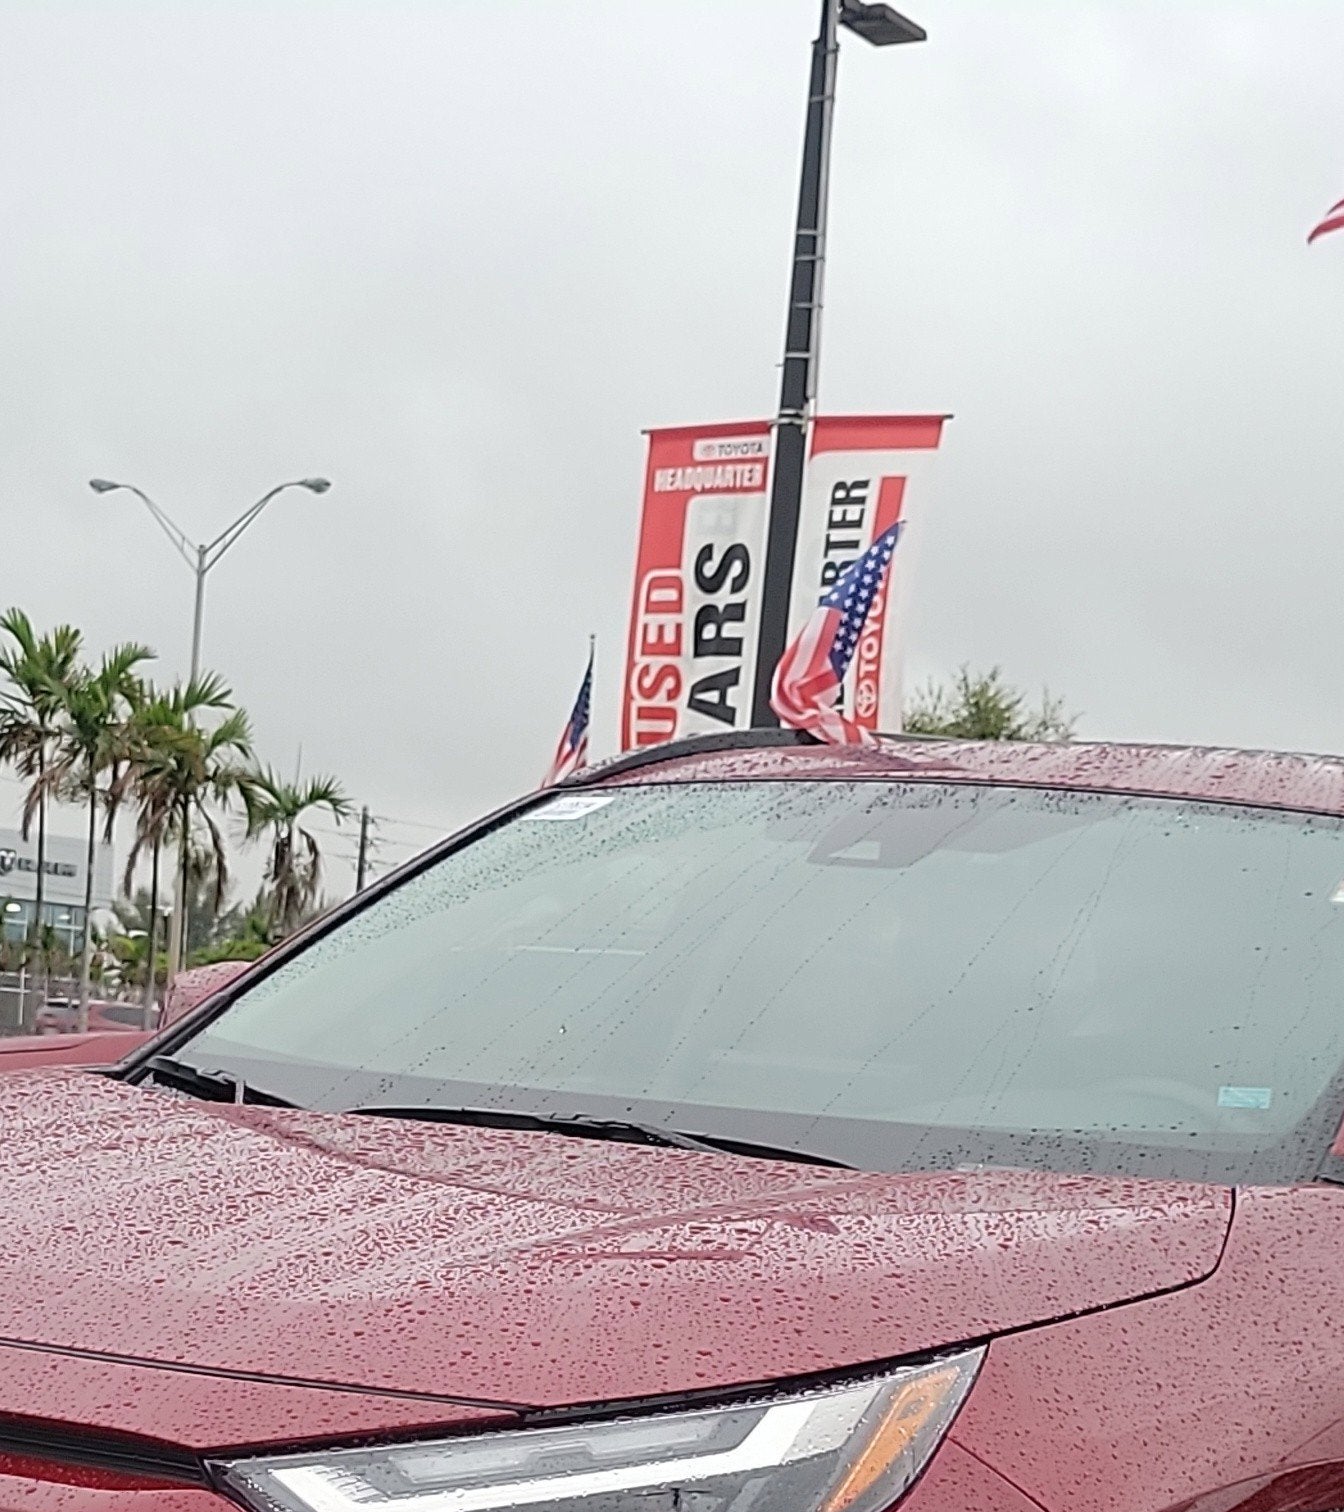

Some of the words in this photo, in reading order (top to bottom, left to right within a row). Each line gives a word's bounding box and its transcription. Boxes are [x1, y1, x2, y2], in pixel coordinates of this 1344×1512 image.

[654, 463, 763, 492] HEADQUARTER
[717, 442, 763, 455] TOYOTA
[636, 575, 684, 746] USED
[686, 542, 751, 737] ARS
